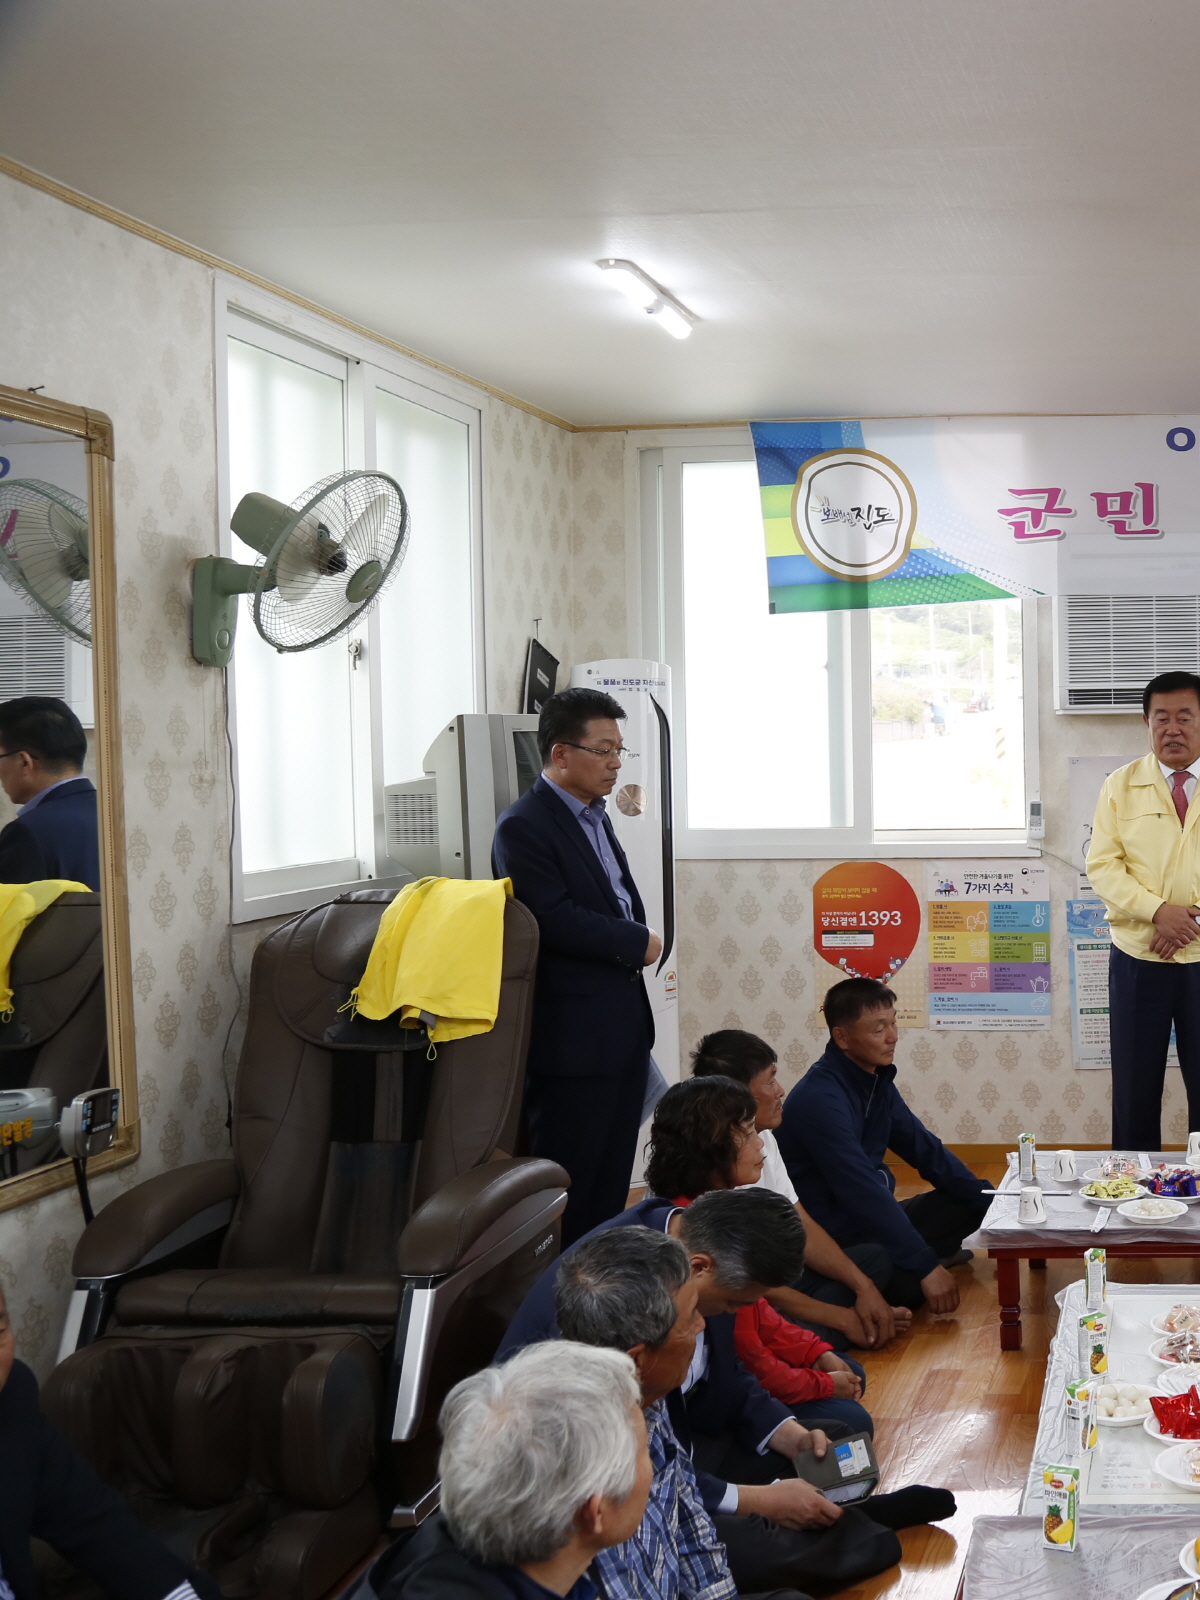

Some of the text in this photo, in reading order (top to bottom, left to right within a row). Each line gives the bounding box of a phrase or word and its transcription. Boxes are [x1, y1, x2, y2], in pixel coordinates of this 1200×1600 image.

[997, 482, 1162, 541] 군민
[964, 882, 1013, 894] 7가지 수칙
[859, 910, 902, 926] 1393
[1044, 1490, 1068, 1499] 파인애플
